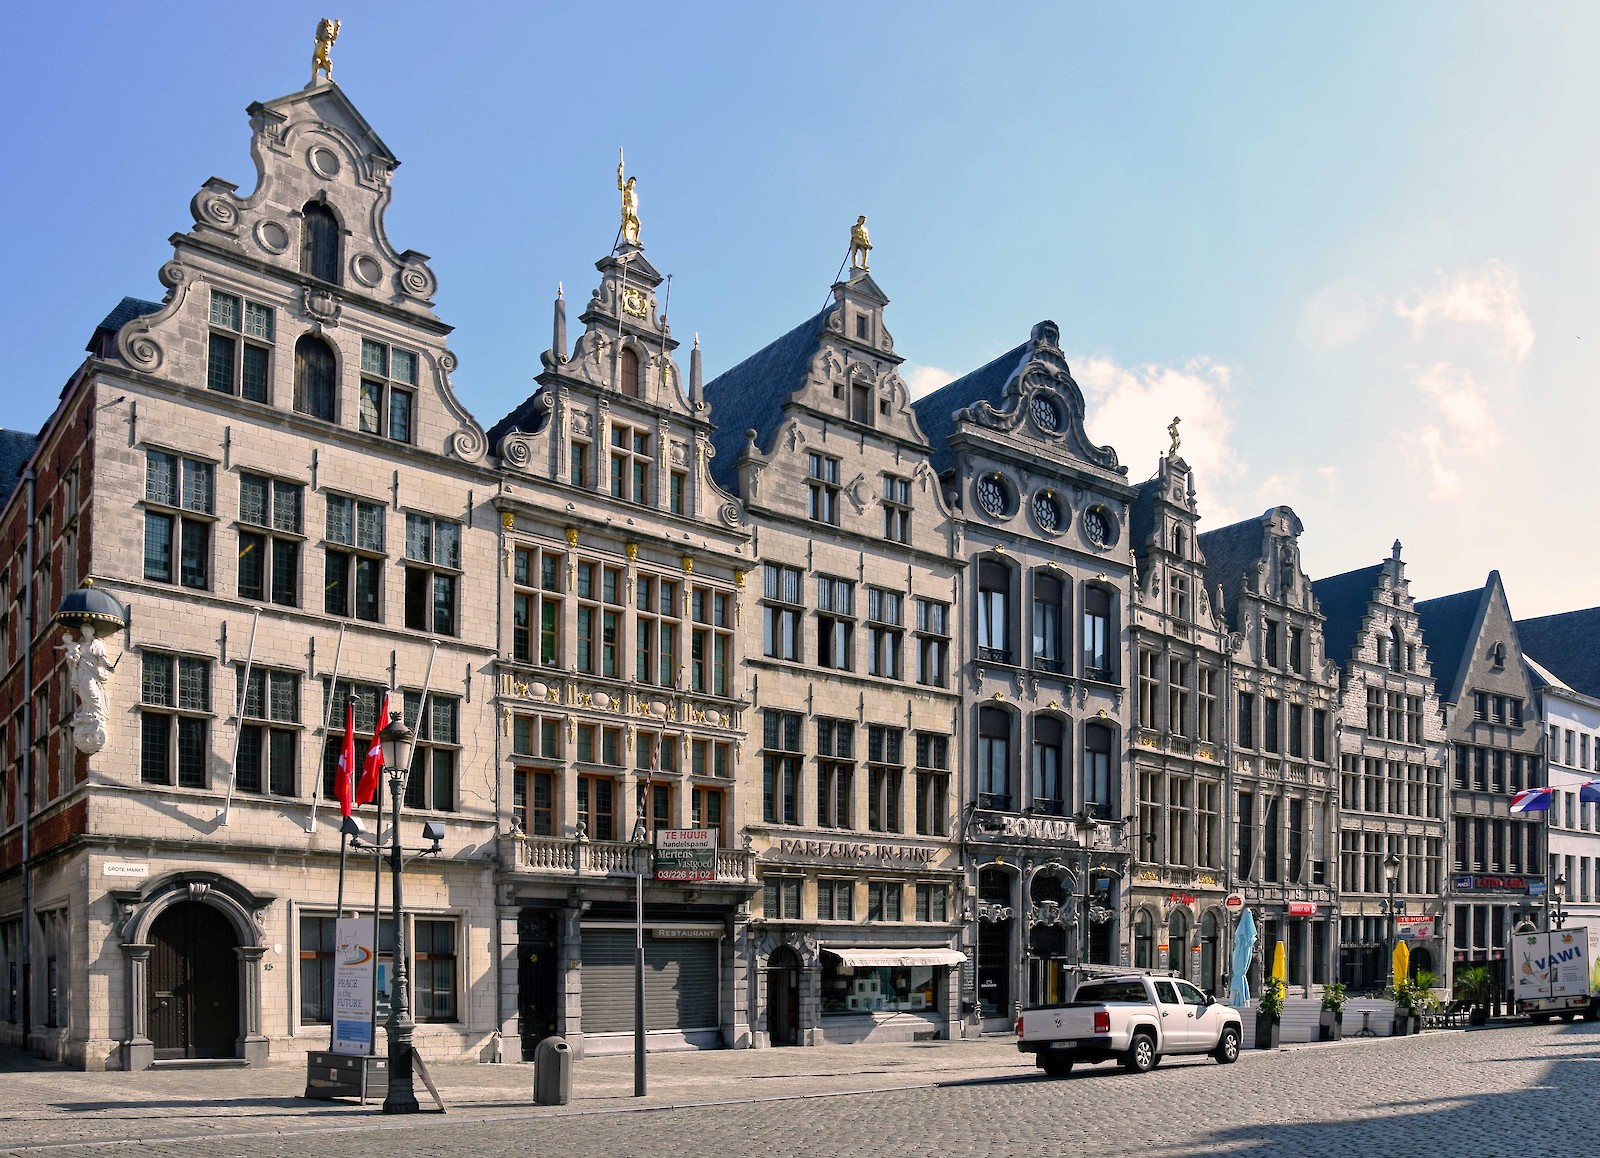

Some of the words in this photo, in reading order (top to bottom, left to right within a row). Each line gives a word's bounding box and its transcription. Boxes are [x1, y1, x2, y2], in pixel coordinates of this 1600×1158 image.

[1002, 816, 1110, 844] BONAPATE
[665, 831, 677, 840] TE
[680, 831, 707, 839] HUUR
[658, 850, 693, 858] Mertens
[780, 839, 870, 858] PARFUMS
[876, 845, 894, 861] IN
[899, 846, 939, 863] FINE
[678, 858, 714, 870] Vastgoed
[658, 871, 687, 879] 03/226
[689, 871, 698, 879] 21
[700, 871, 711, 879] 02
[658, 929, 715, 937] RESTAURANT
[1534, 946, 1582, 970] VAWI
[338, 979, 358, 987] PEACE
[337, 989, 341, 997] is
[343, 989, 351, 997] the
[337, 998, 363, 1008] FUTURE
